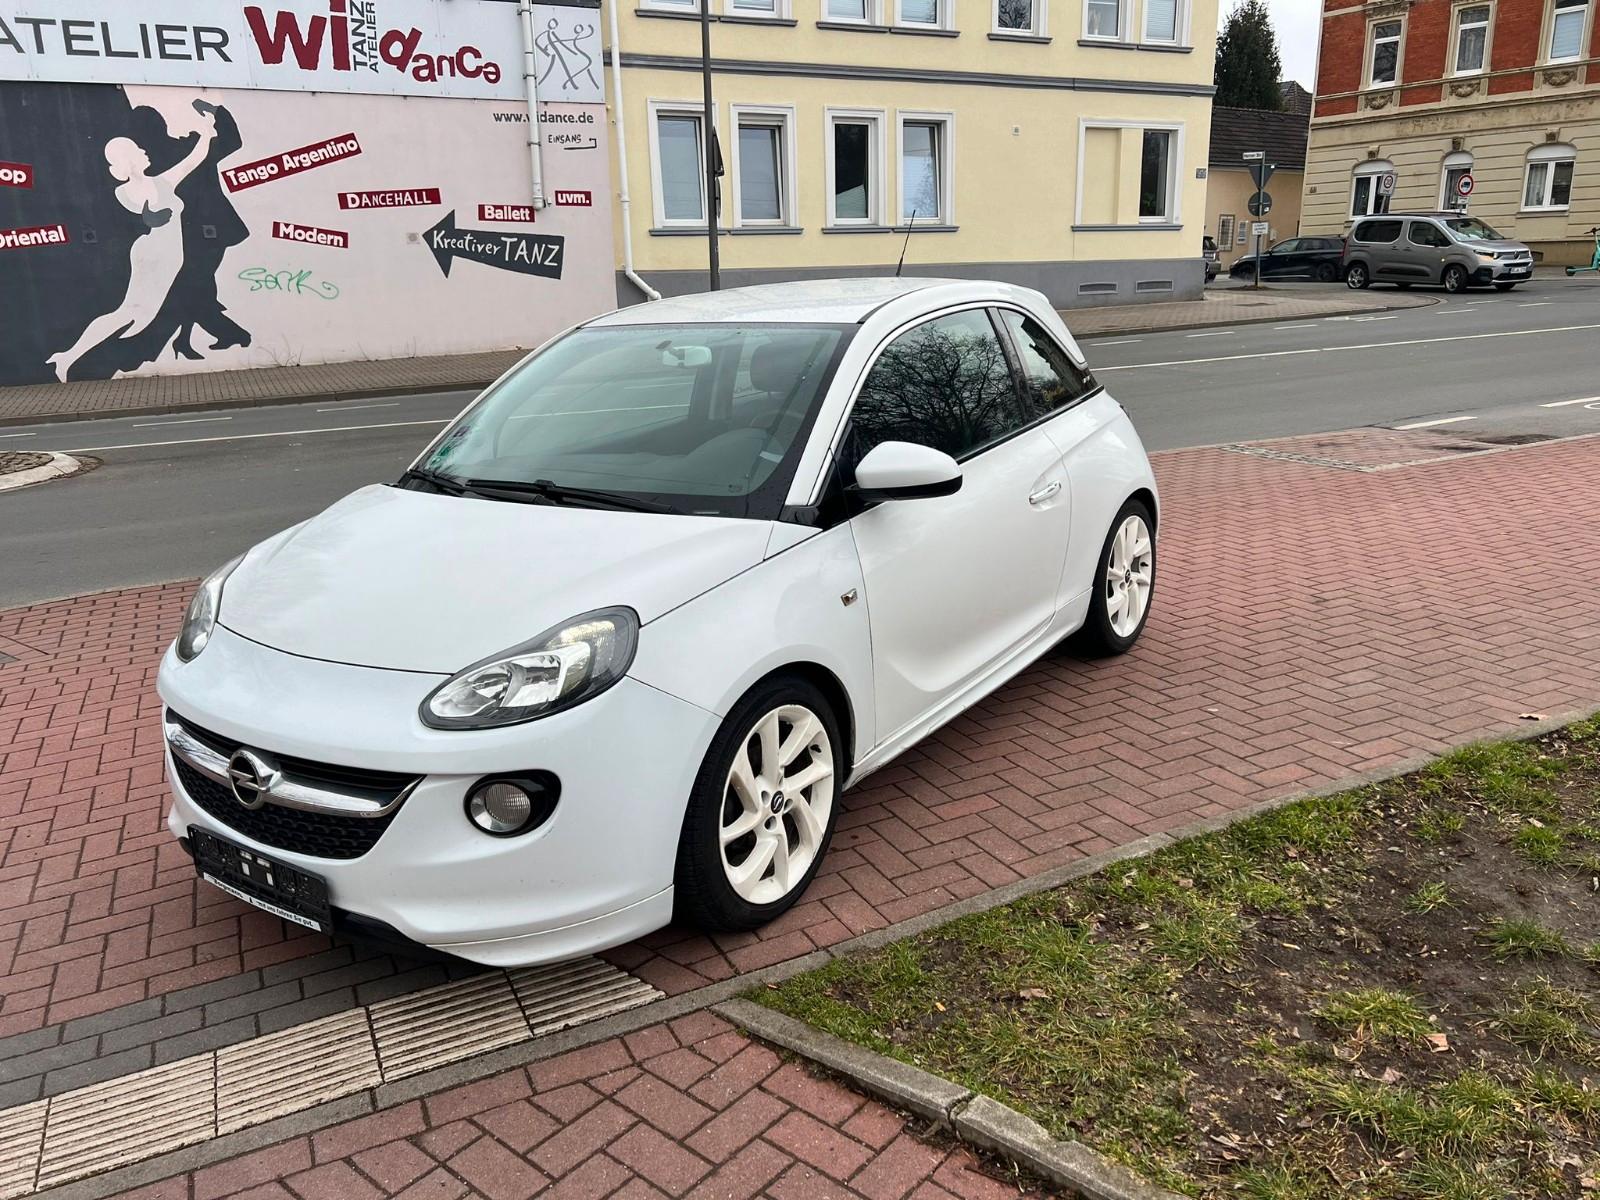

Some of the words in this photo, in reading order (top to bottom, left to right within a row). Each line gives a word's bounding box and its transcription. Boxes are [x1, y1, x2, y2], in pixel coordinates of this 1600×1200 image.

[350, 0, 368, 71] TANZ
[366, 2, 379, 73] ATELIER
[493, 111, 594, 123] www.idance.de
[226, 163, 279, 186] Tango
[282, 139, 358, 171] Argentino
[484, 206, 531, 221] Ballett
[557, 193, 590, 204] uvm.
[279, 223, 344, 247] Modern
[433, 230, 501, 256] Kreativer
[501, 236, 560, 266] TANZ
